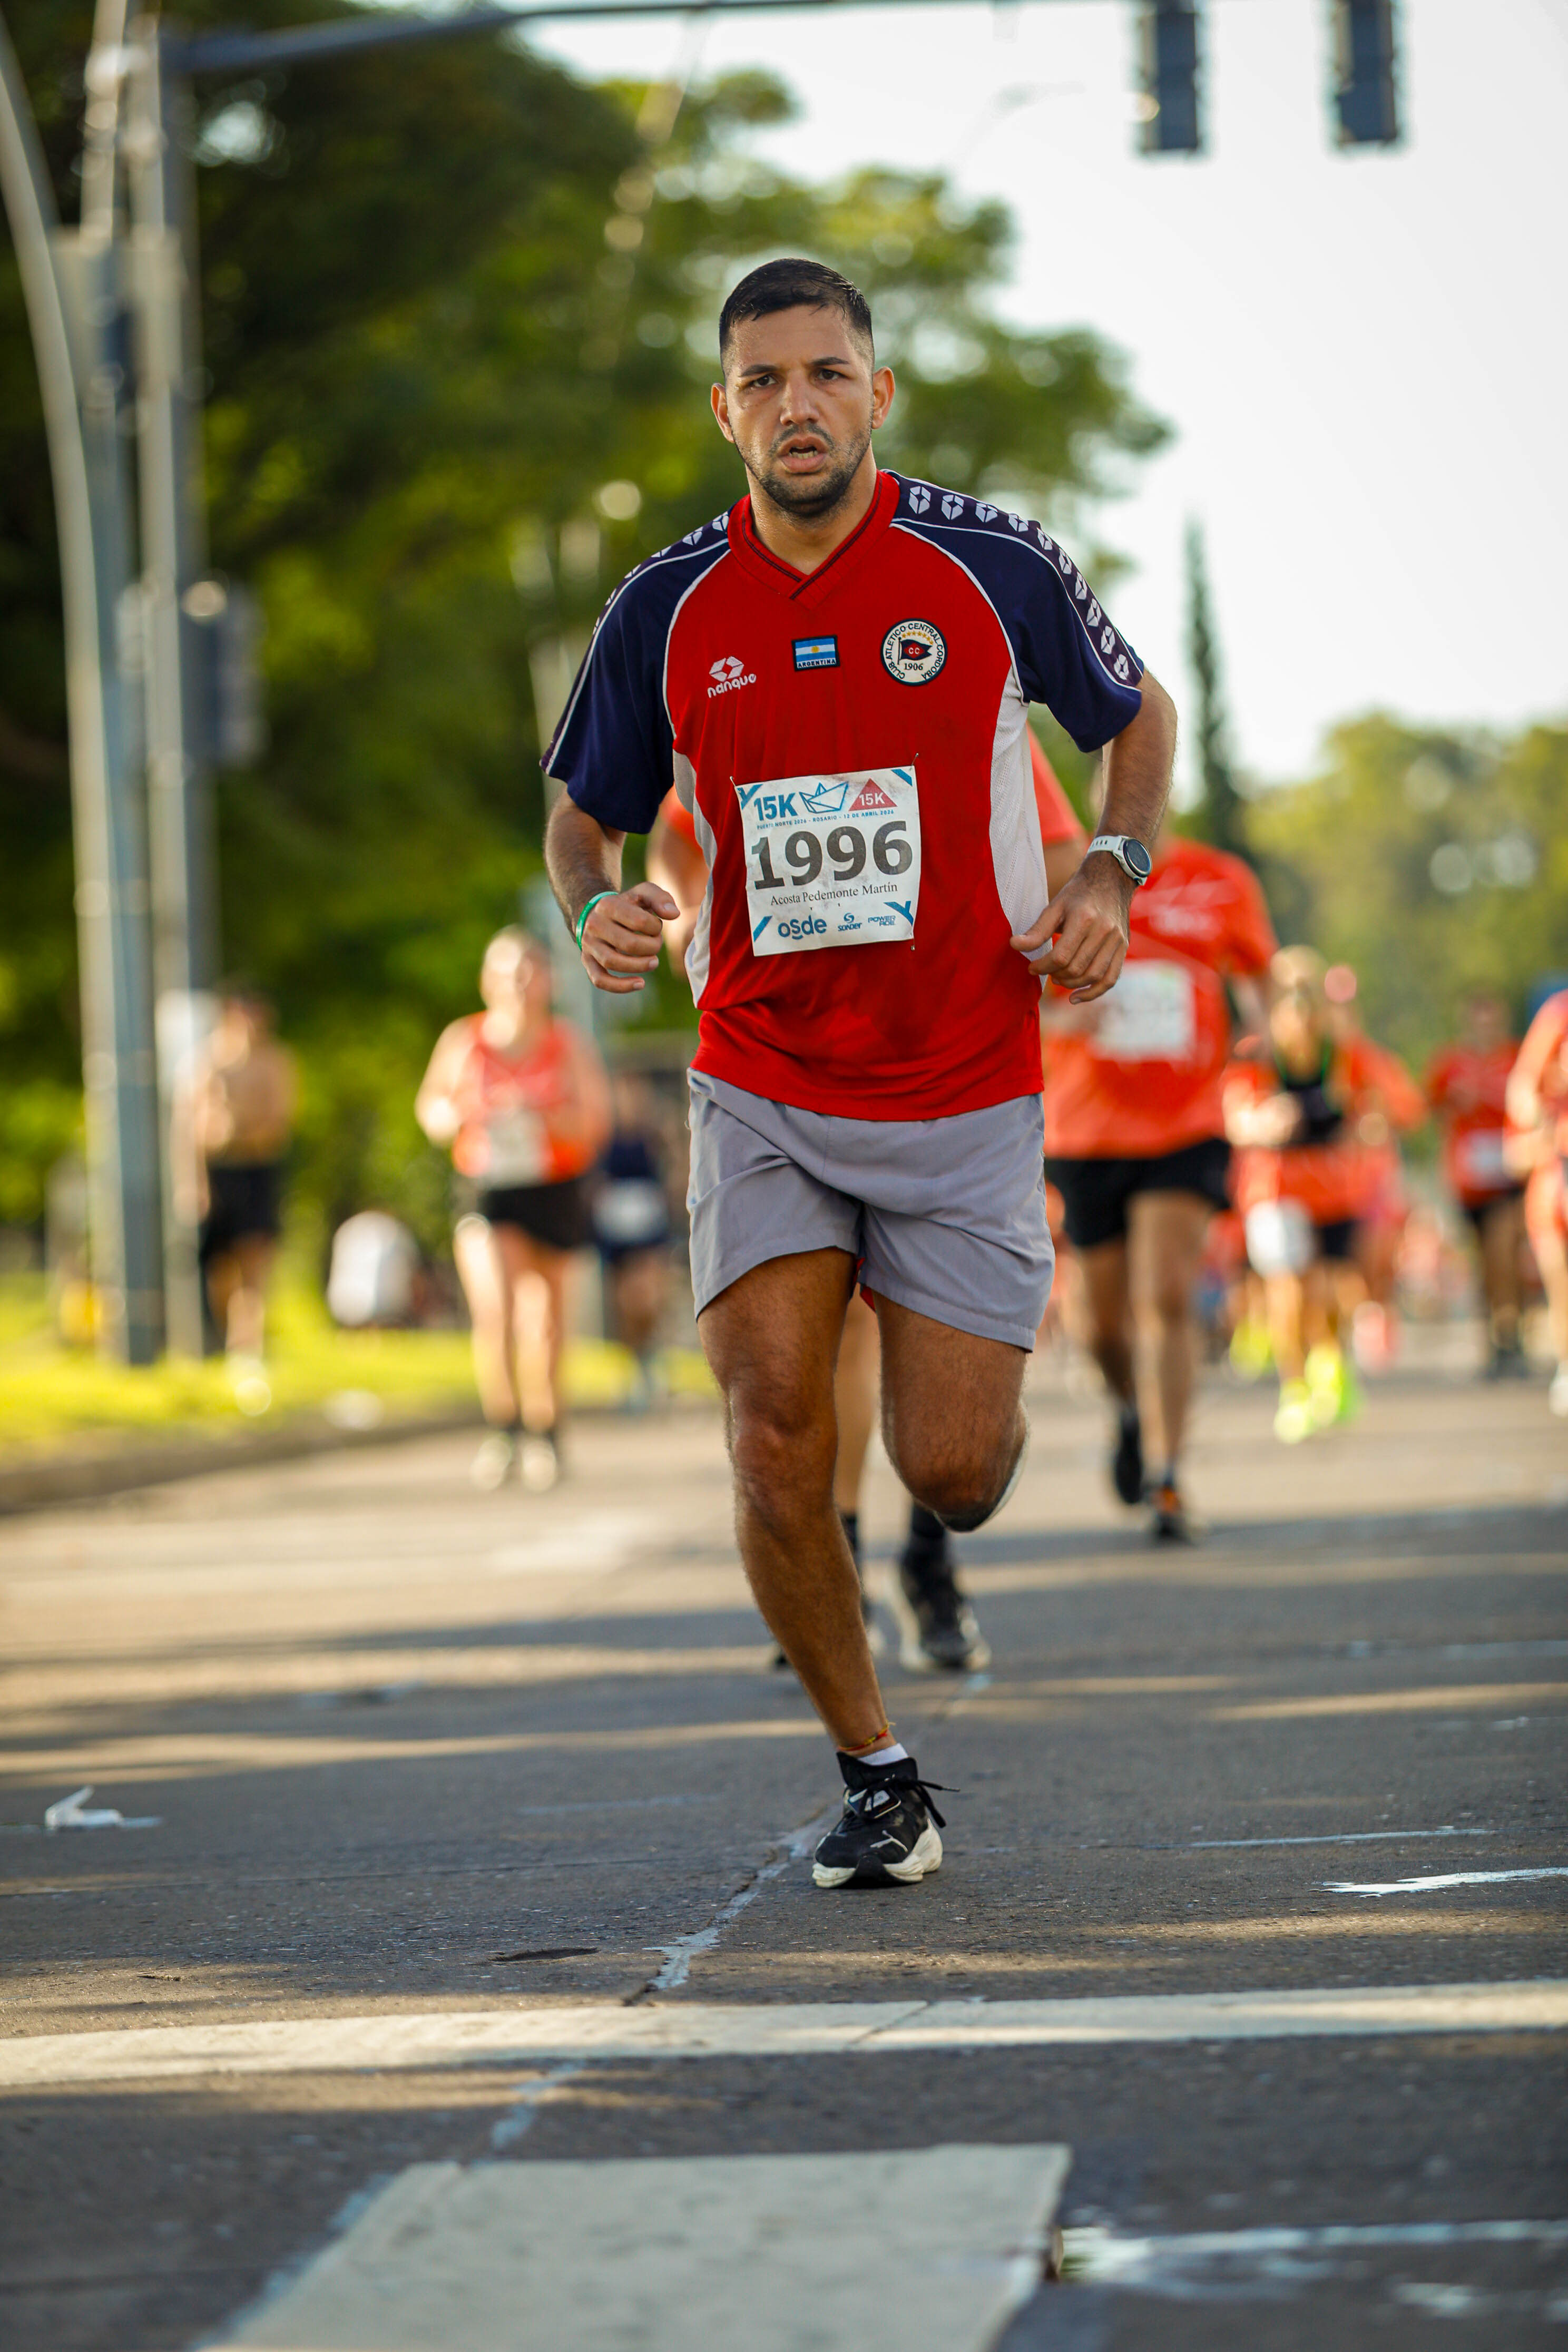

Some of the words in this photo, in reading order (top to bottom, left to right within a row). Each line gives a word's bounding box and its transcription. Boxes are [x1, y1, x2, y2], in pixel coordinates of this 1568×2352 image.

[885, 625, 906, 661] ATLETICO
[908, 623, 940, 645] CENTRAL
[798, 658, 836, 668] ARGENTINA
[889, 661, 905, 679] CLUB
[921, 644, 944, 680] CORDOBA
[707, 673, 757, 698] nanque
[753, 792, 798, 821] 15K
[859, 792, 886, 806] 15K
[751, 820, 913, 890] 1996
[771, 895, 801, 905] Acosta
[803, 888, 859, 902] Pedemonte
[862, 881, 898, 895] Martín
[778, 915, 827, 940] osde
